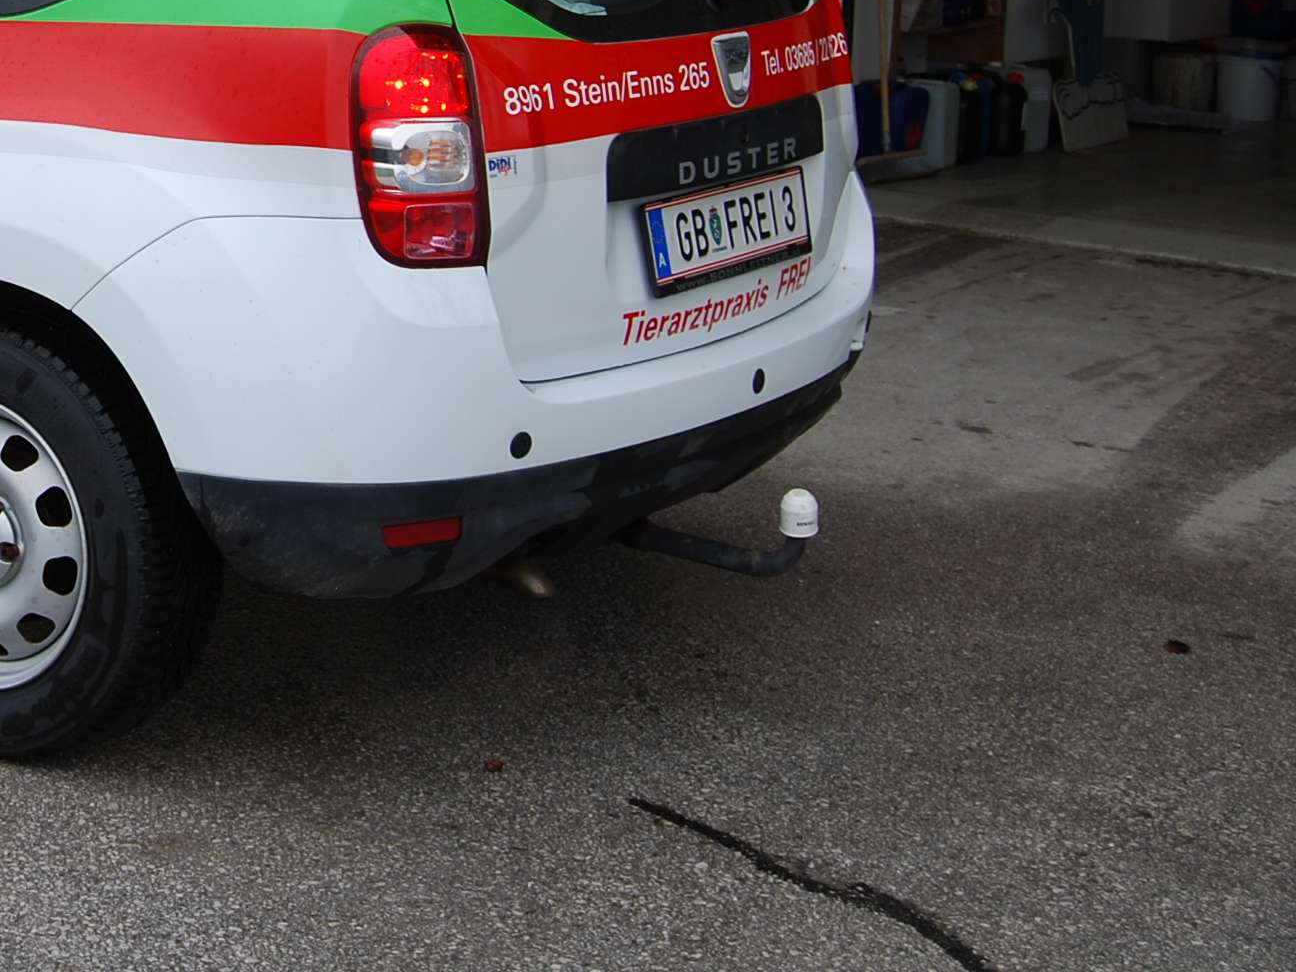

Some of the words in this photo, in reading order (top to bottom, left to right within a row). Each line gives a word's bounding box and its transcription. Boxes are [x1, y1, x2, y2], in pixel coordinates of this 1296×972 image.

[760, 48, 785, 76] Tel.
[784, 40, 815, 71] 03685
[503, 82, 555, 116] 8961
[562, 70, 675, 108] Stein/Enns
[678, 61, 711, 92] 265
[678, 137, 797, 185] DUSTER
[675, 208, 710, 262] GB
[622, 278, 770, 346] Tierarztpraxis
[776, 256, 812, 301] FREI
